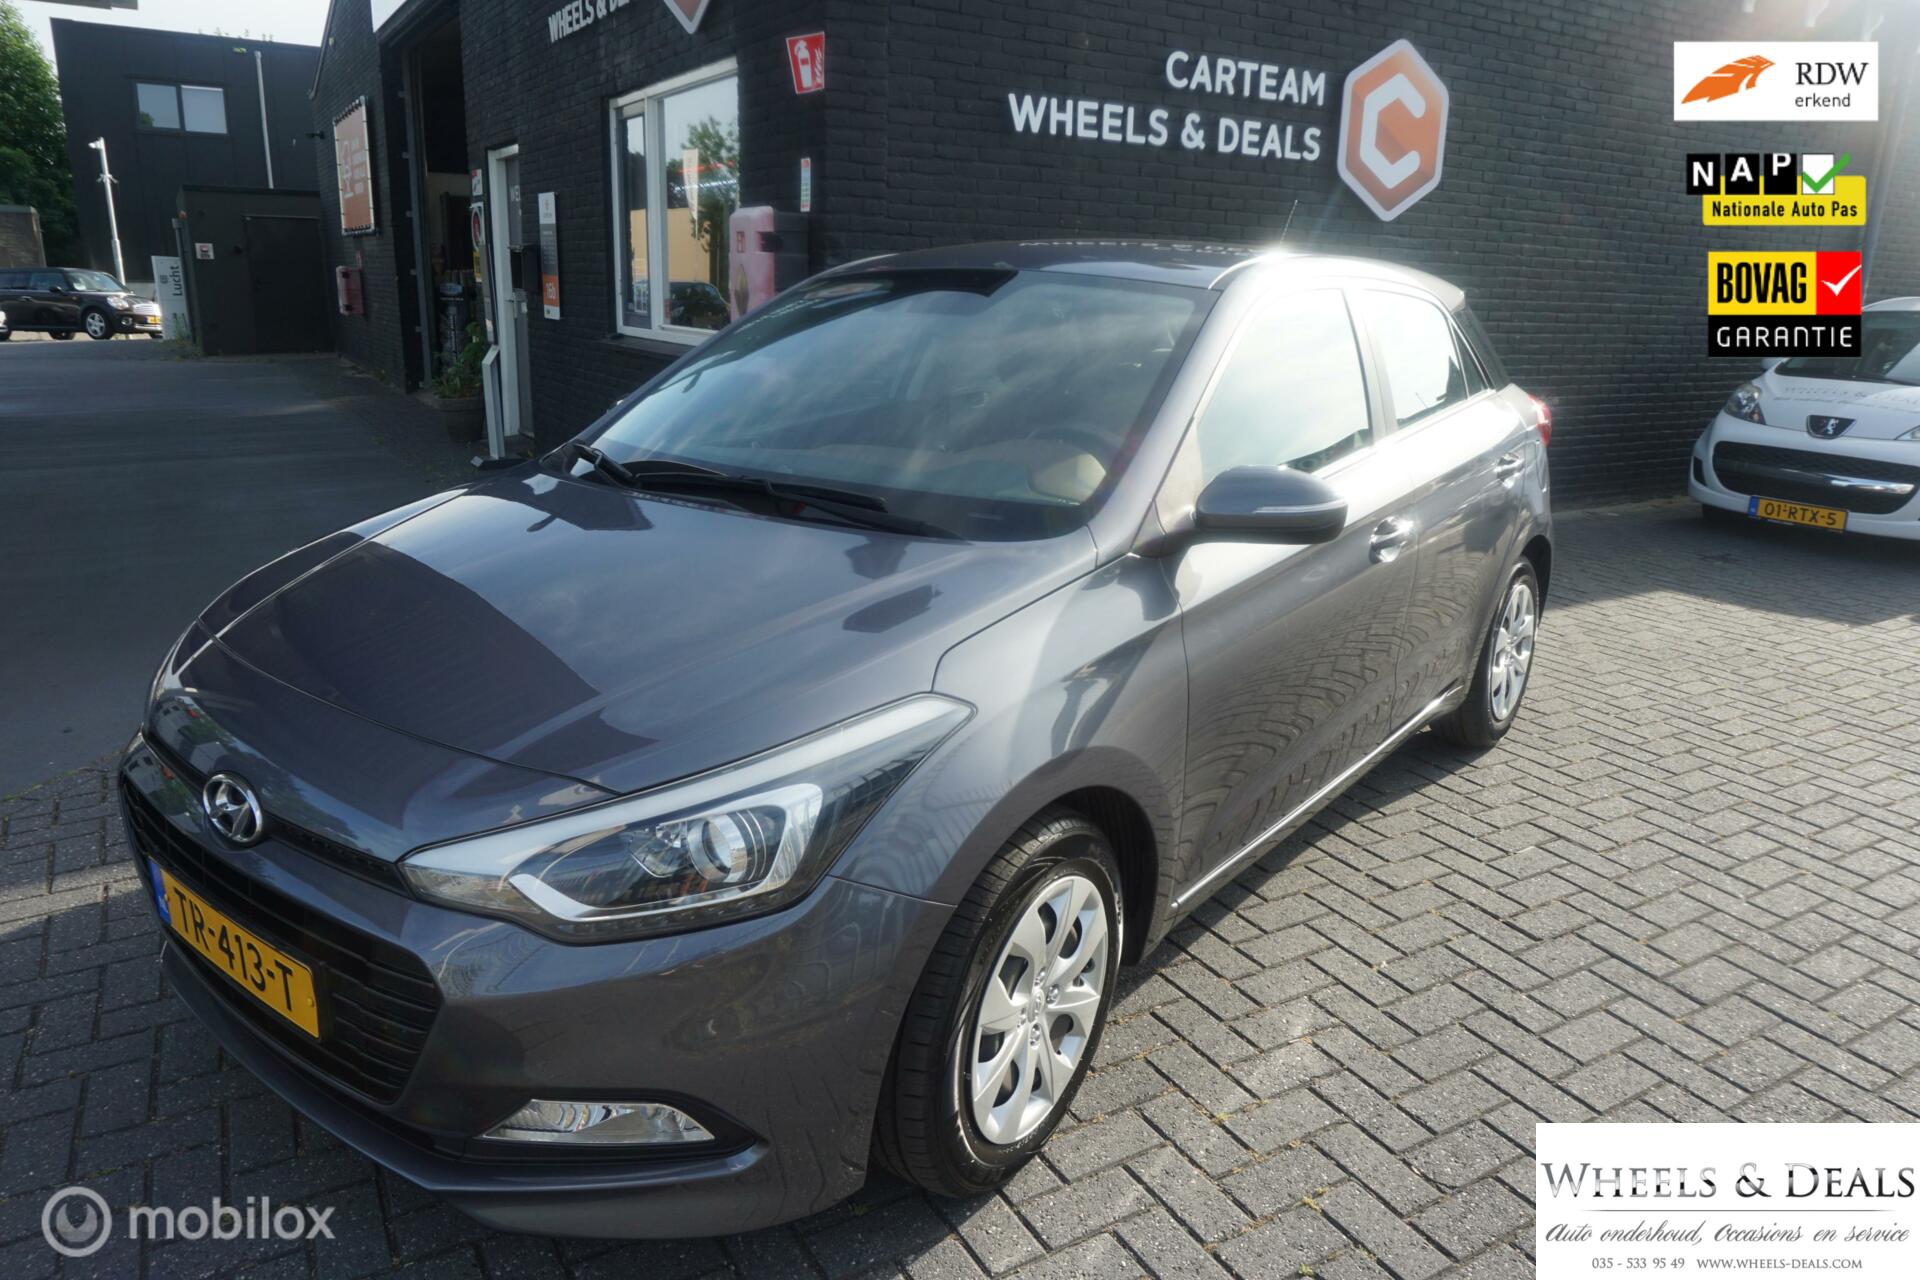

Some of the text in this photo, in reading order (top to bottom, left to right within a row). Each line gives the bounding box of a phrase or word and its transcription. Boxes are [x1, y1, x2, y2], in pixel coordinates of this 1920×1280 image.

[548, 0, 595, 43] WHEELS
[1165, 50, 1326, 107] CARTEAM
[1007, 92, 1322, 162] WHEELS & DEALS
[169, 265, 183, 296] Lucht
[1764, 502, 1837, 526] 01-RTX-5
[174, 887, 294, 1012] TR-413-T
